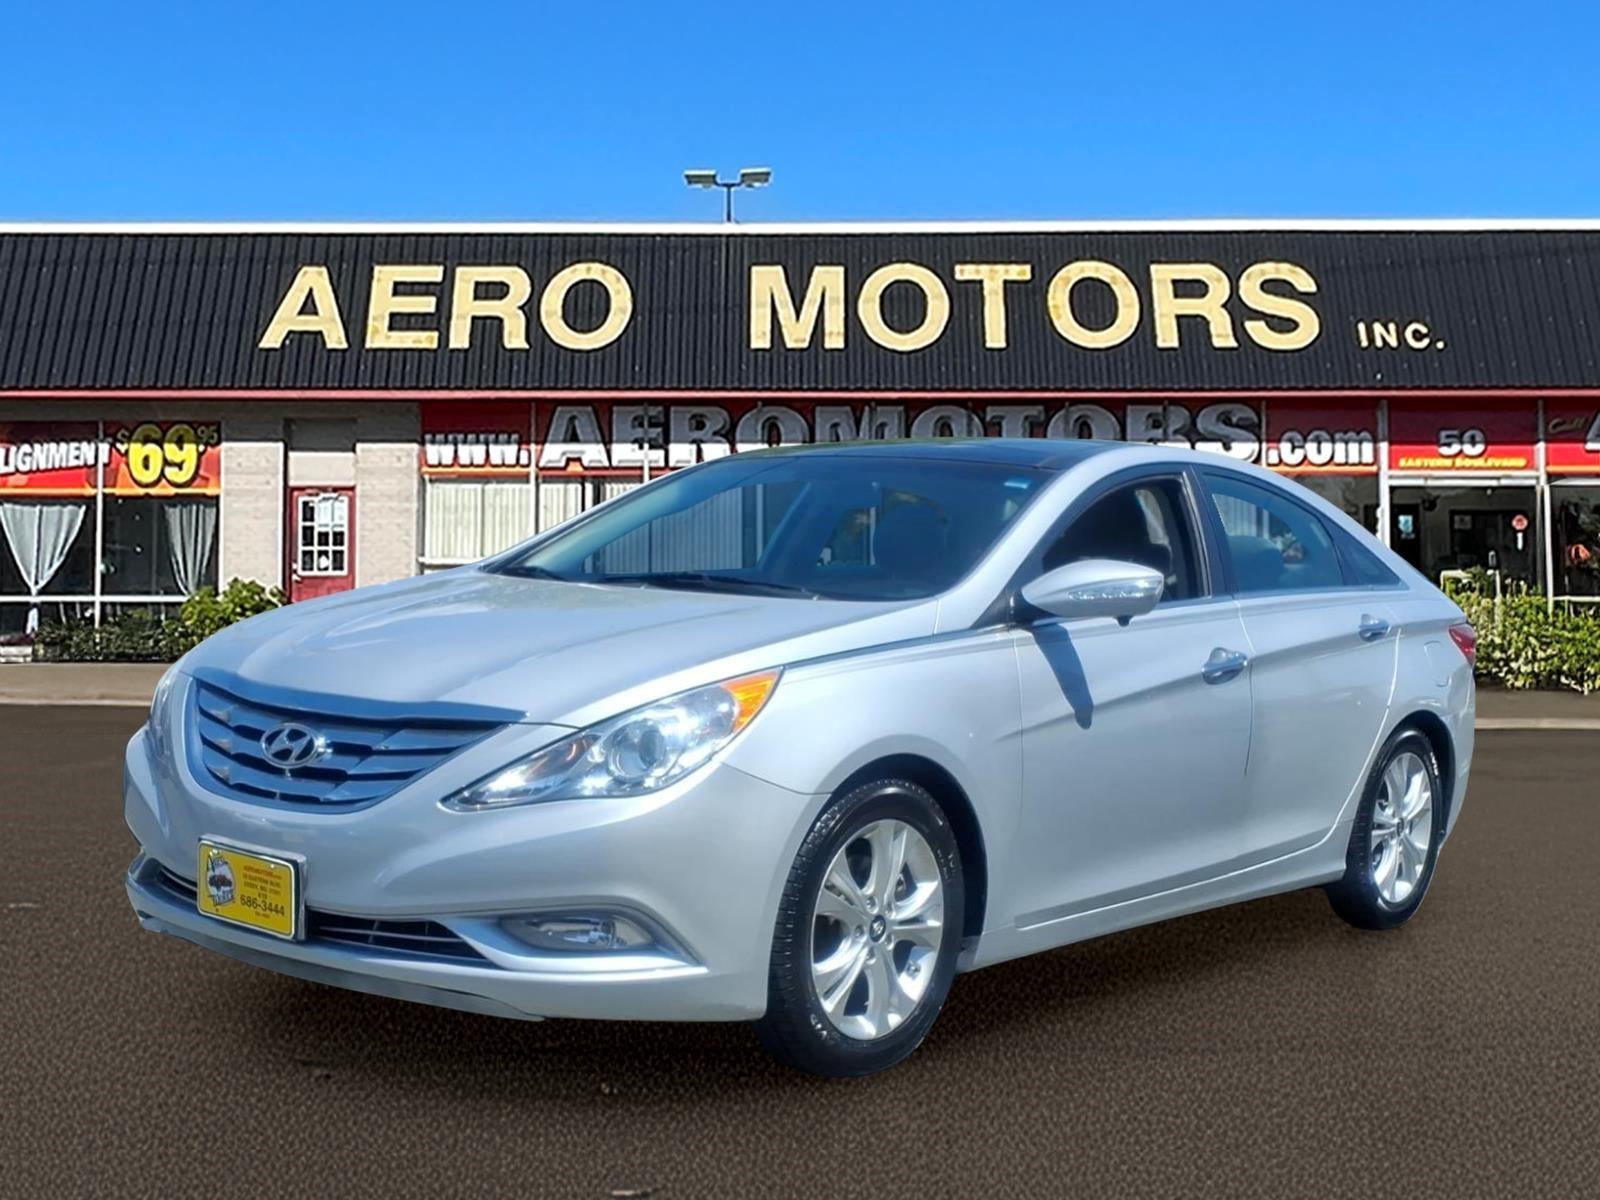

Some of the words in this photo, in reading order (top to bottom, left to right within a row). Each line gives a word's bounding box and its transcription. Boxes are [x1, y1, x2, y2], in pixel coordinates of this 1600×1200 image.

[258, 261, 634, 351] AERO
[749, 260, 1321, 353] MOTORS
[1357, 321, 1446, 350] INC.
[1438, 429, 1485, 456] 50
[240, 894, 284, 916] 686-3444
